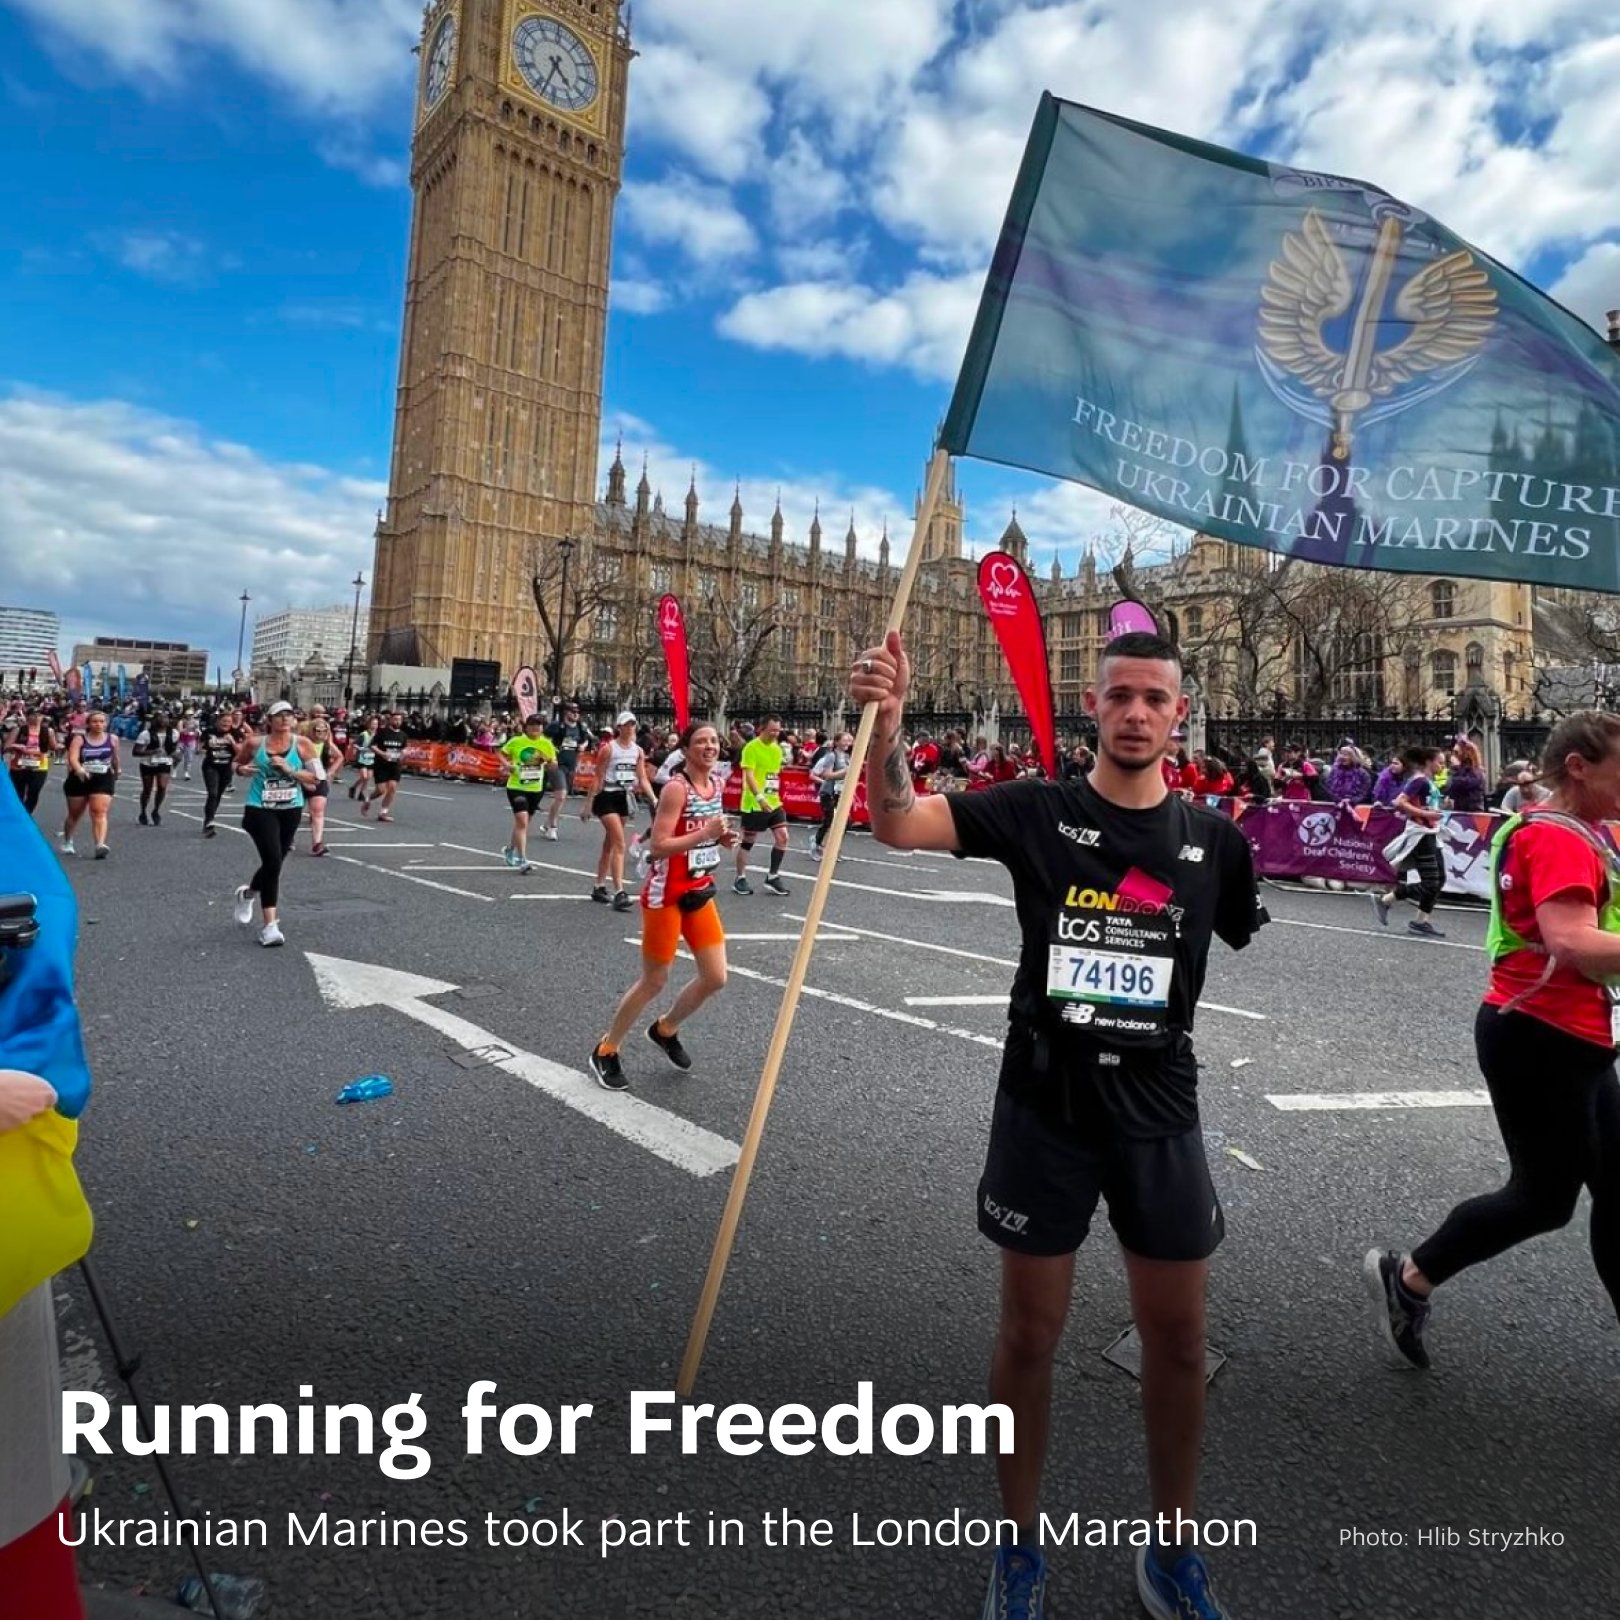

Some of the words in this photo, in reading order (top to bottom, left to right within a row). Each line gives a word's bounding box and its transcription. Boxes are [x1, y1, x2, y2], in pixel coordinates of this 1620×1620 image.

[1072, 397, 1271, 488] FREEDOM
[1281, 461, 1374, 500] FOR
[1116, 458, 1347, 543] UKRAINIAN
[1354, 515, 1591, 560] MARINES
[1333, 836, 1374, 851] National
[1303, 847, 1327, 858] Deaf
[1328, 848, 1375, 862] Children's
[1339, 860, 1376, 875] Society
[1057, 911, 1101, 942] tcs
[1105, 915, 1133, 927] TATA
[1105, 926, 1168, 942] CONSULTANCY
[1105, 936, 1145, 949] SERVICES
[1069, 957, 1154, 995] 74196
[1094, 1016, 1116, 1028] new
[1117, 1017, 1158, 1031] balance
